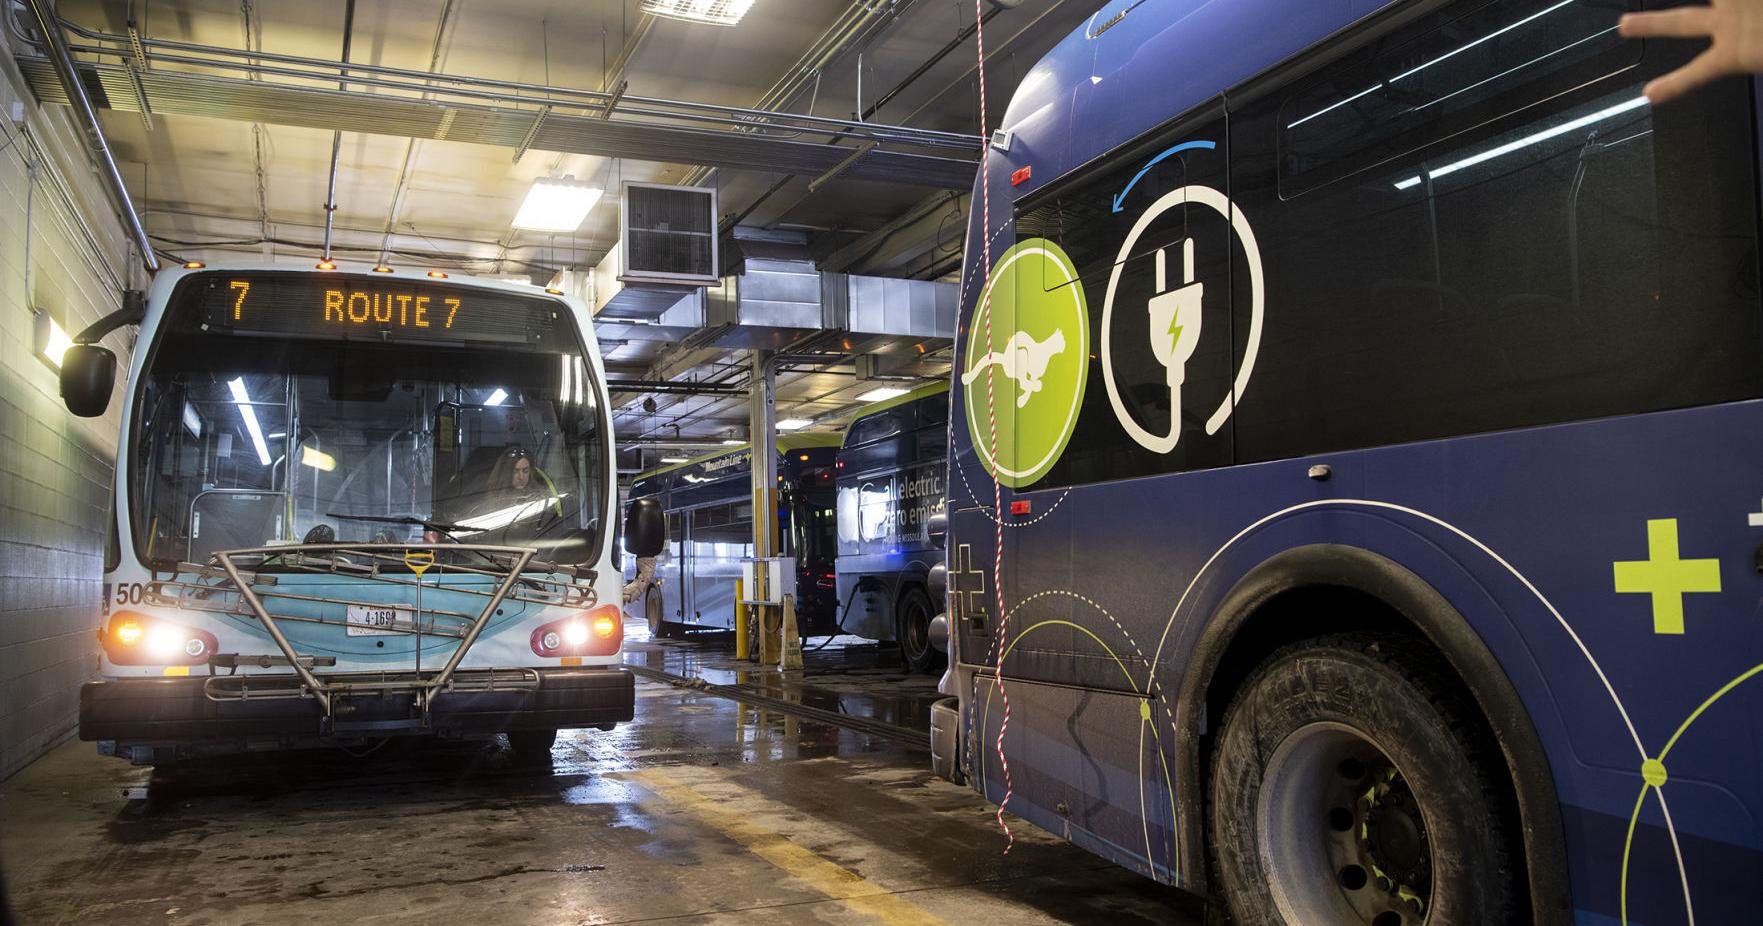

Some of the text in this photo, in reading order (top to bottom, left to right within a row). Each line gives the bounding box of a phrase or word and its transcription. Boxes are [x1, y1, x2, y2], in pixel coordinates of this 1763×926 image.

[230, 281, 461, 328] 7 ROUTE 7
[705, 454, 742, 473] Mountain Line
